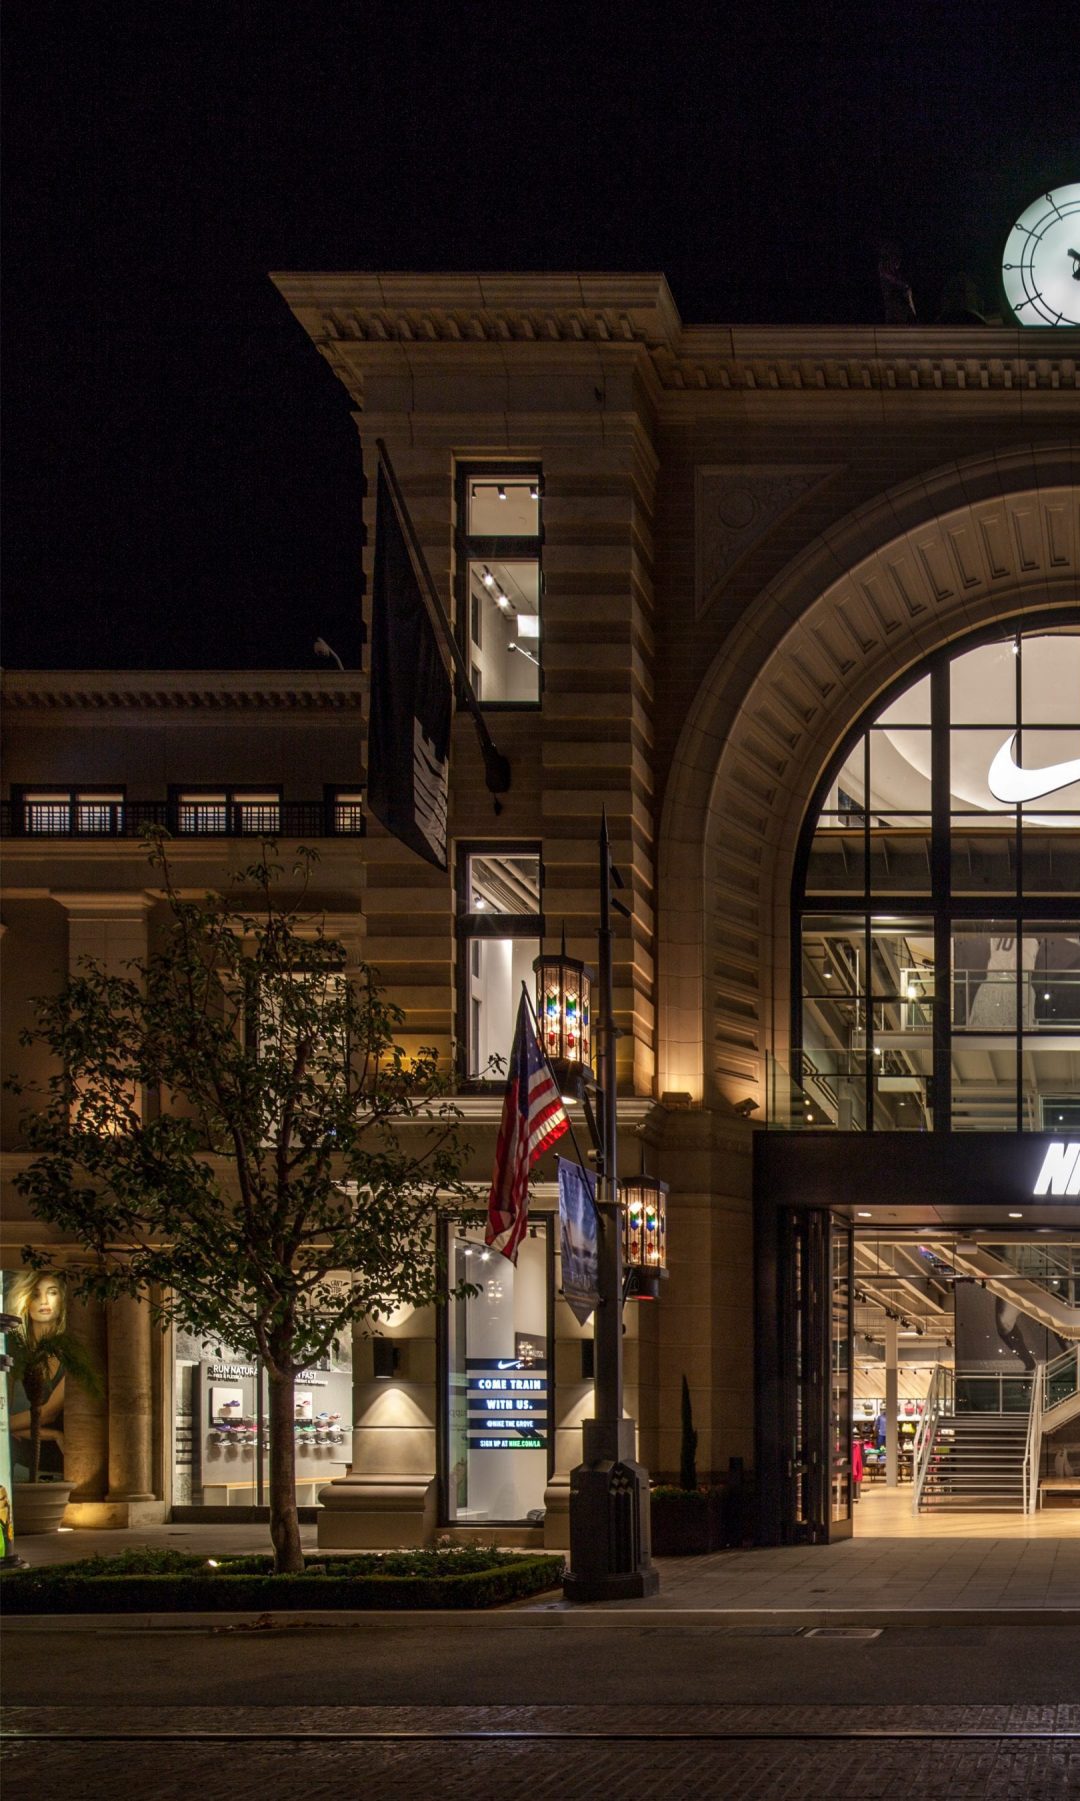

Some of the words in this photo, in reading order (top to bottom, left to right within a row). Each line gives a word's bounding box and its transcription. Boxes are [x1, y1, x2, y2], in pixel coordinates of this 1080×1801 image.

[213, 1364, 230, 1373] RUN
[230, 1365, 258, 1376] NATURA
[301, 1371, 317, 1379] FAST
[478, 1379, 507, 1389] COME
[510, 1379, 540, 1389] TRAIN
[486, 1399, 513, 1410] WITH
[516, 1399, 533, 1410] US.
